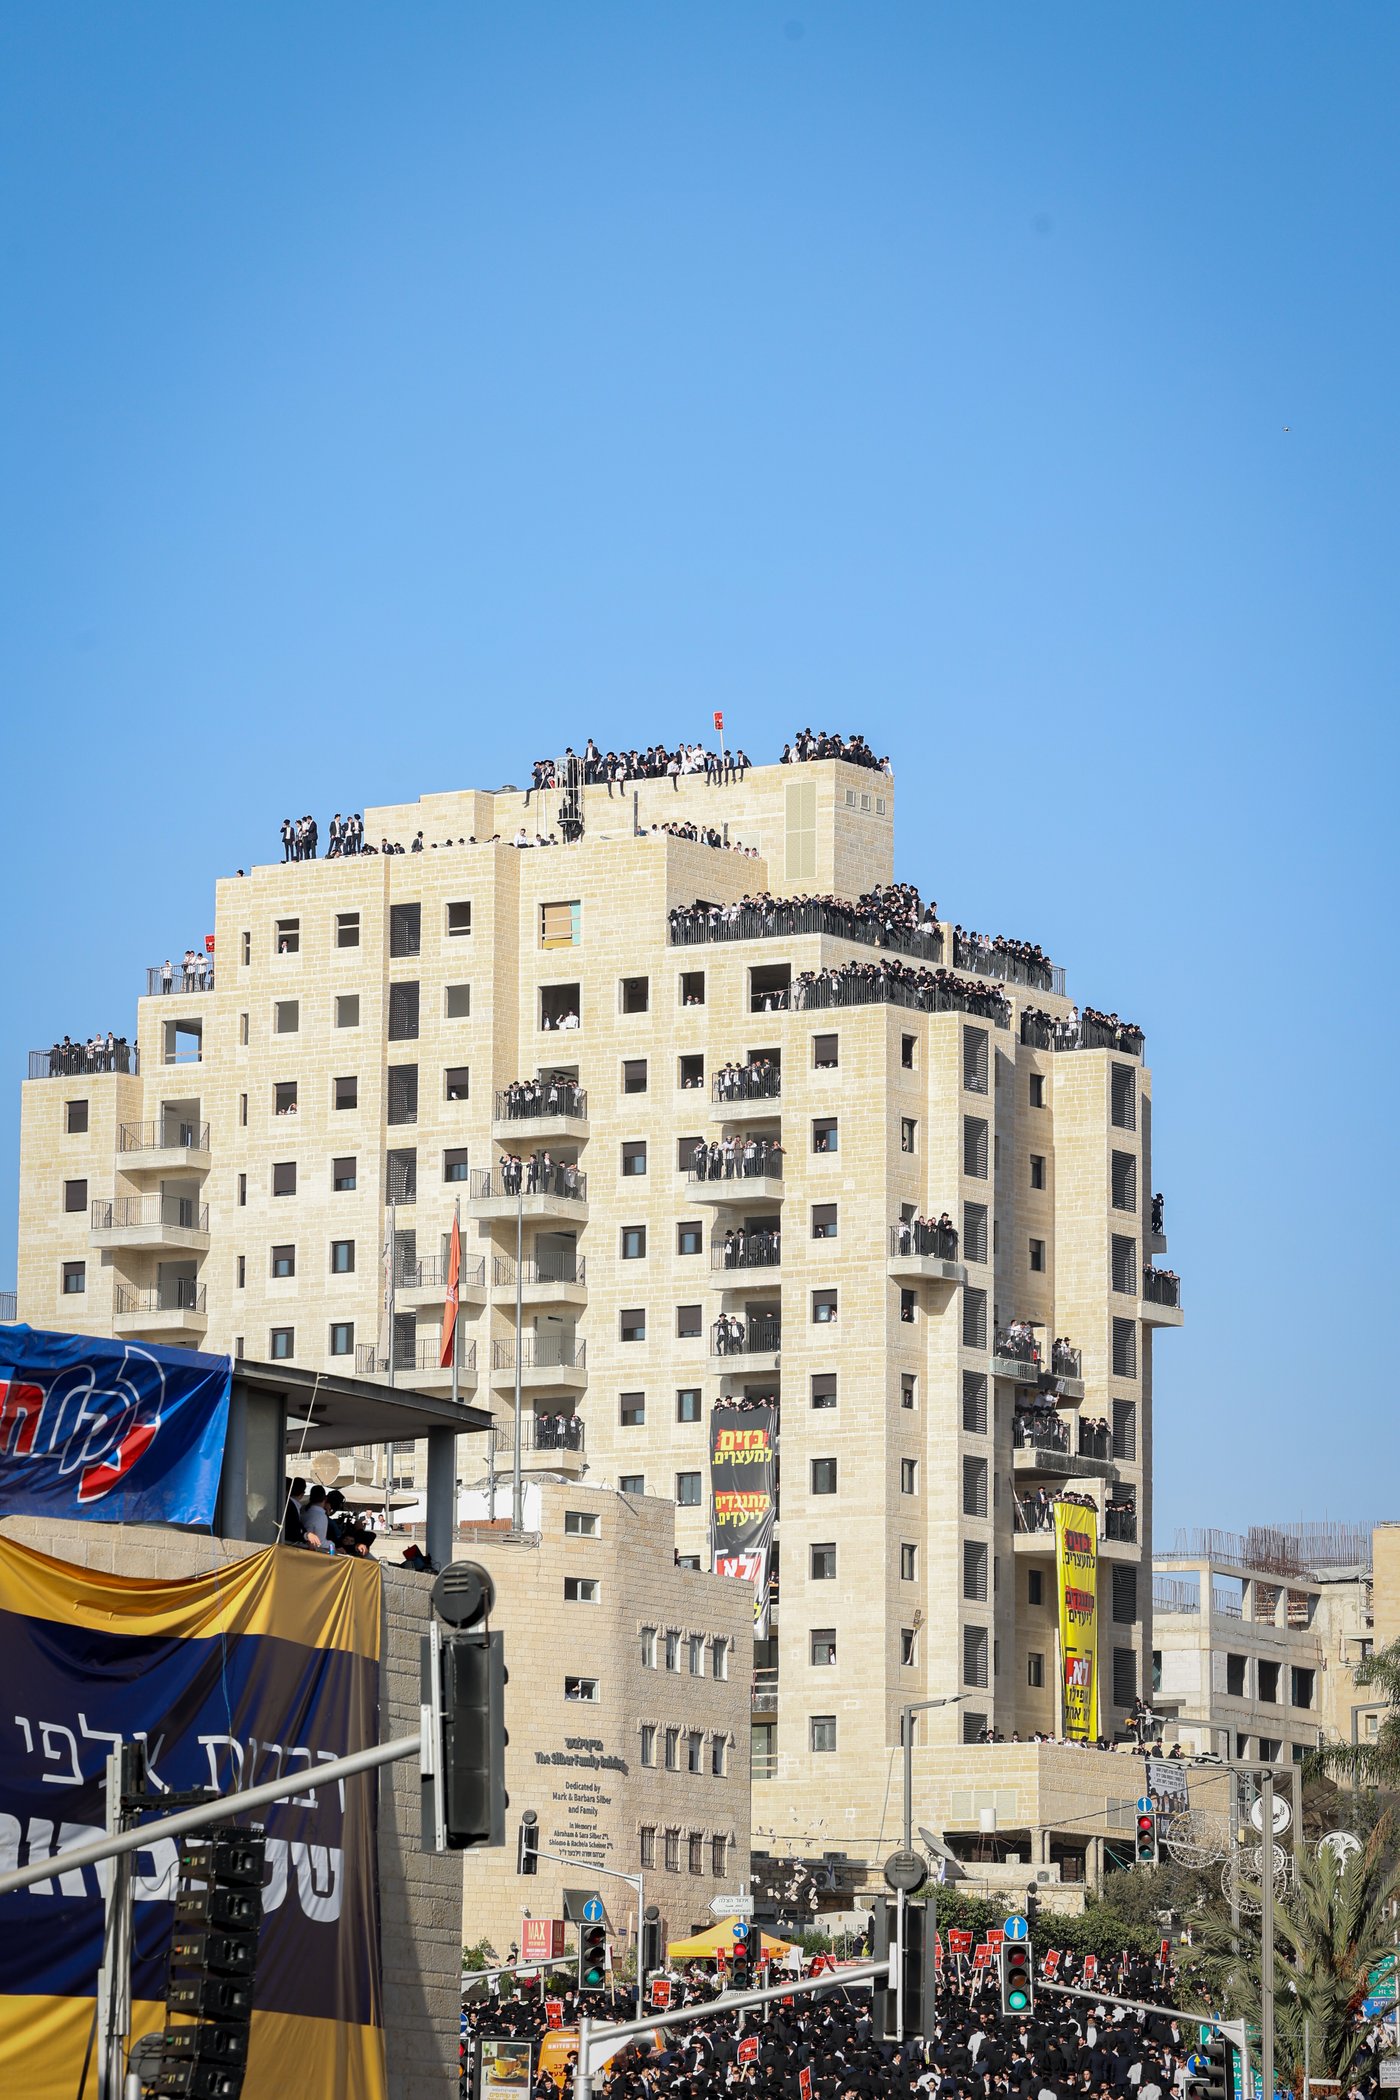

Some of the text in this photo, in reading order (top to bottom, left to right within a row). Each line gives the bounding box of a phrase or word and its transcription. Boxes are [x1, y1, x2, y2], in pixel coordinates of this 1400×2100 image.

[565, 1781, 601, 1794] Dedicated by
[552, 1791, 568, 1801] Mark
[574, 1793, 596, 1803] Barbara
[568, 1805, 599, 1817] and Family
[554, 1830, 574, 1838] Abraham
[528, 1921, 546, 1941] MAX
